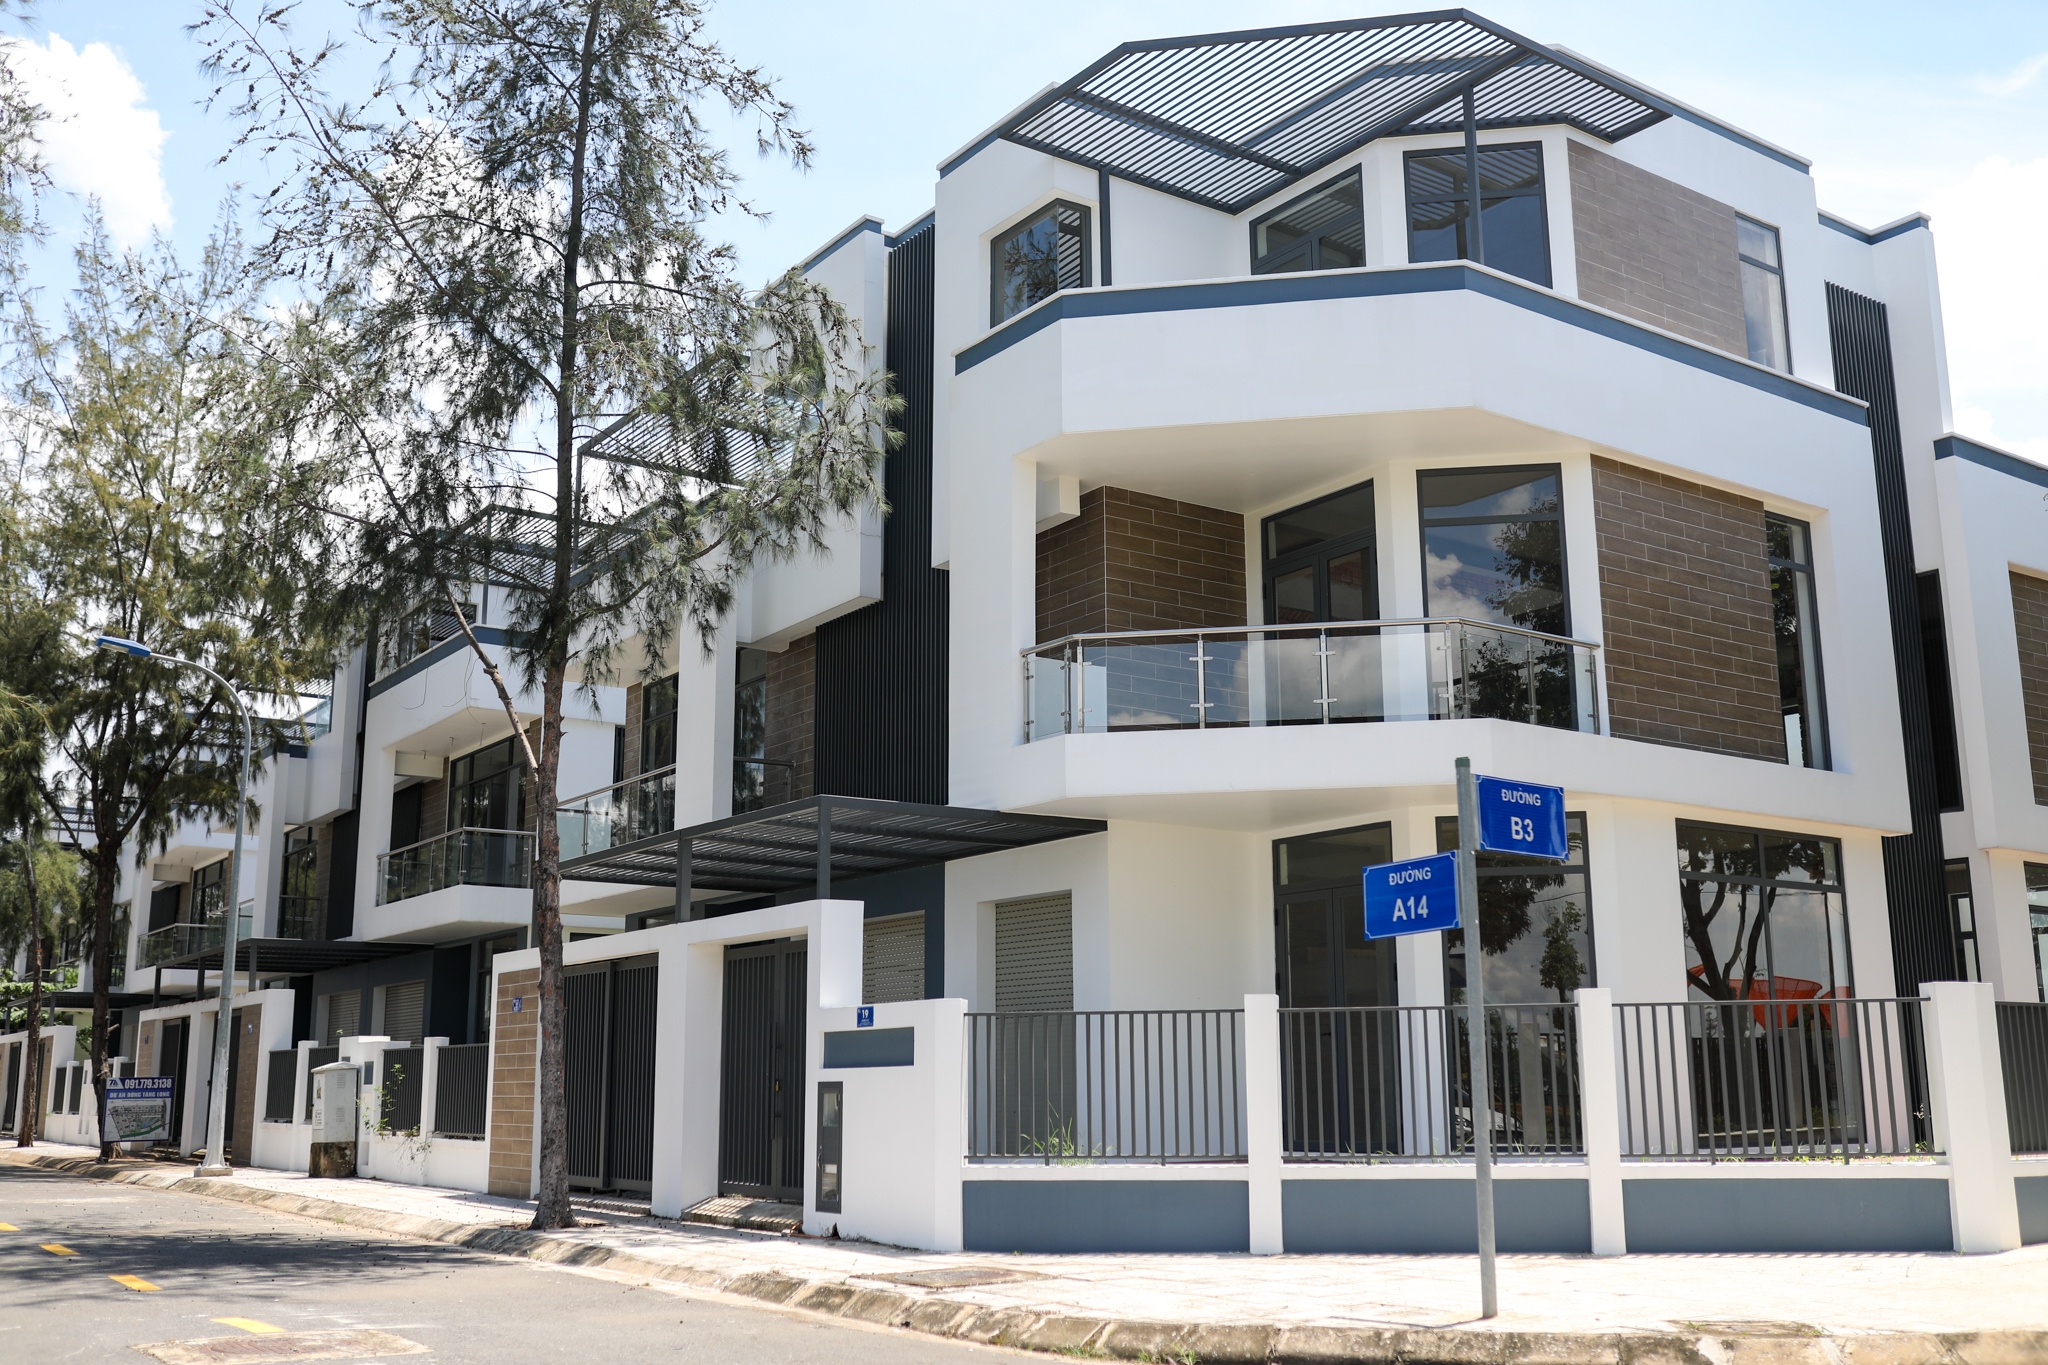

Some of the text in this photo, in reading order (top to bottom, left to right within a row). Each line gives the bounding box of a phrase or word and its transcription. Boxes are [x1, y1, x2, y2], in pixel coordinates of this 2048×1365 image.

[1501, 787, 1541, 806] ĐƯỜNG
[1510, 816, 1534, 842] B3
[1388, 866, 1432, 885] ĐƯỜNG
[1392, 895, 1429, 922] A14
[862, 1009, 869, 1019] 19
[124, 1079, 172, 1089] 091.779.3138
